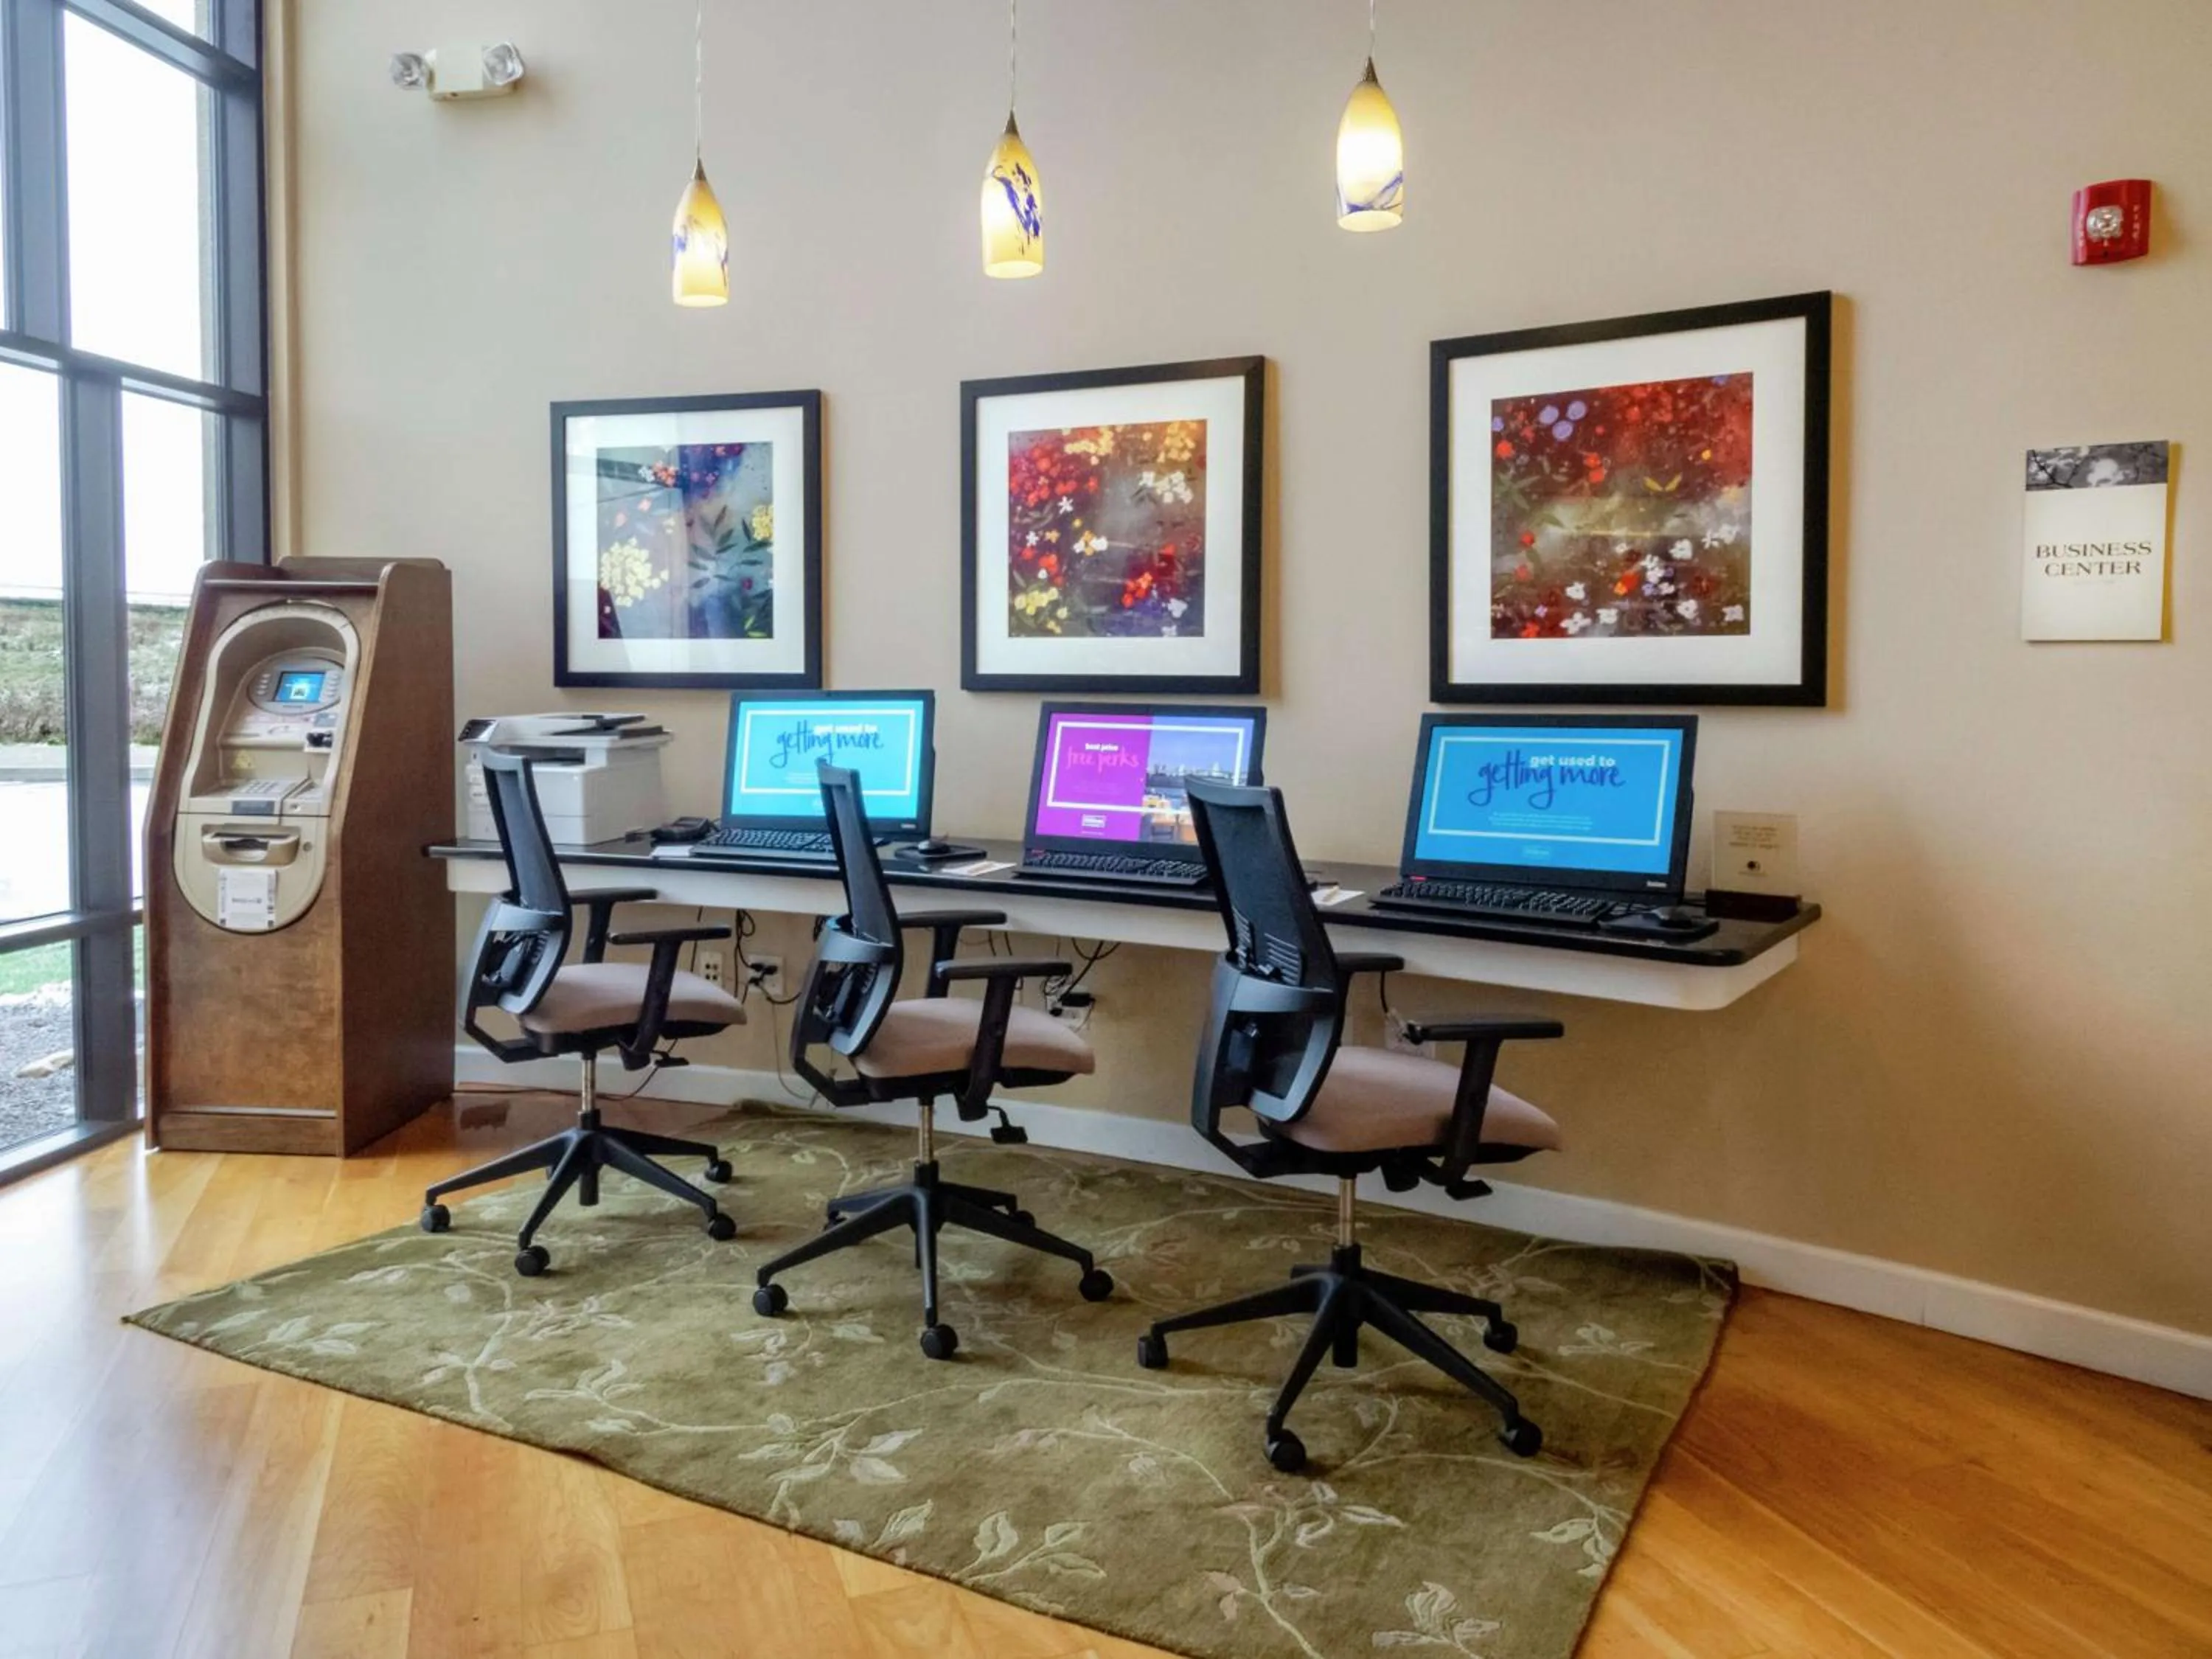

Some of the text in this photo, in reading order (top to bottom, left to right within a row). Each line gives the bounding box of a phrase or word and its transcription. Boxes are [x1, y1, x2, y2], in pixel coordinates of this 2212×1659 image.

[2036, 542, 2152, 559] BUSINESS
[2044, 560, 2141, 577] CENTER
[769, 719, 884, 768] getting more
[1530, 755, 1616, 768] get used to
[1467, 749, 1627, 810] getting more
